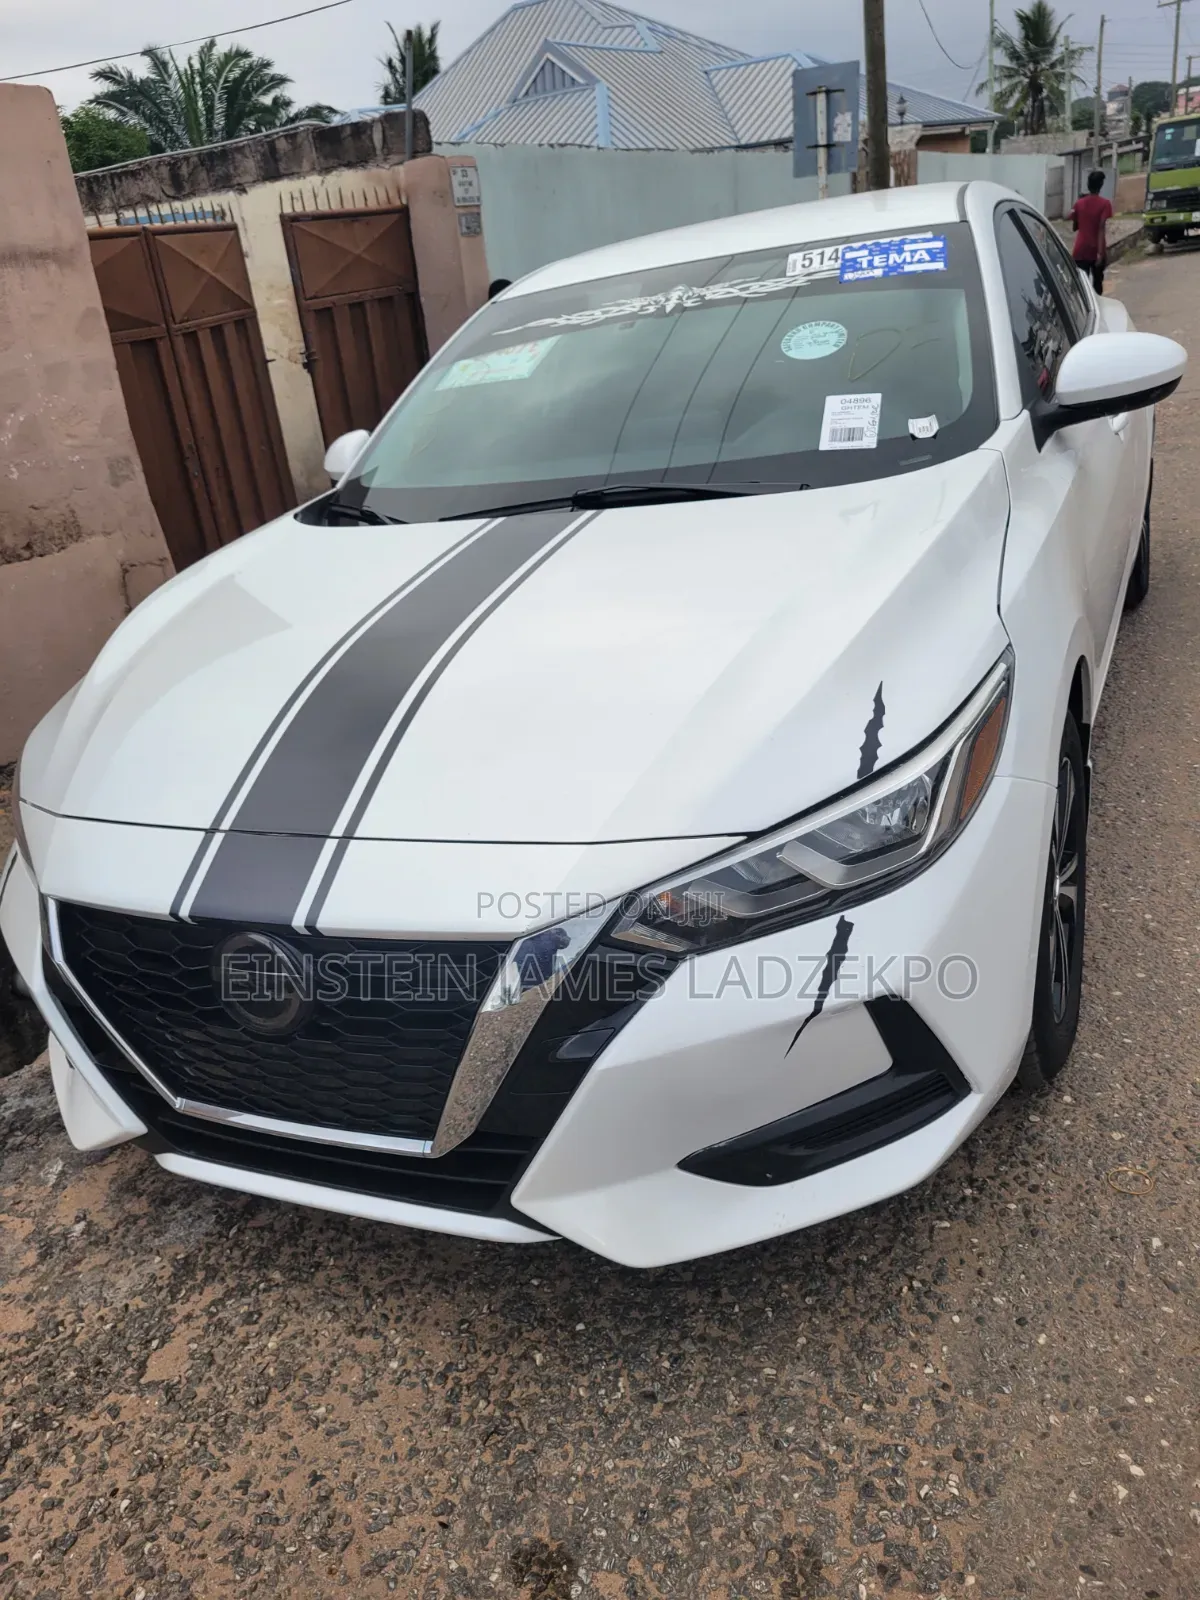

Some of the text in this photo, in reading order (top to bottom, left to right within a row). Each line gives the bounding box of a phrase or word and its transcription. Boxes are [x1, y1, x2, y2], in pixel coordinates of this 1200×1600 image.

[801, 247, 840, 268] 514
[858, 250, 931, 268] TEMA
[840, 397, 872, 405] 04896
